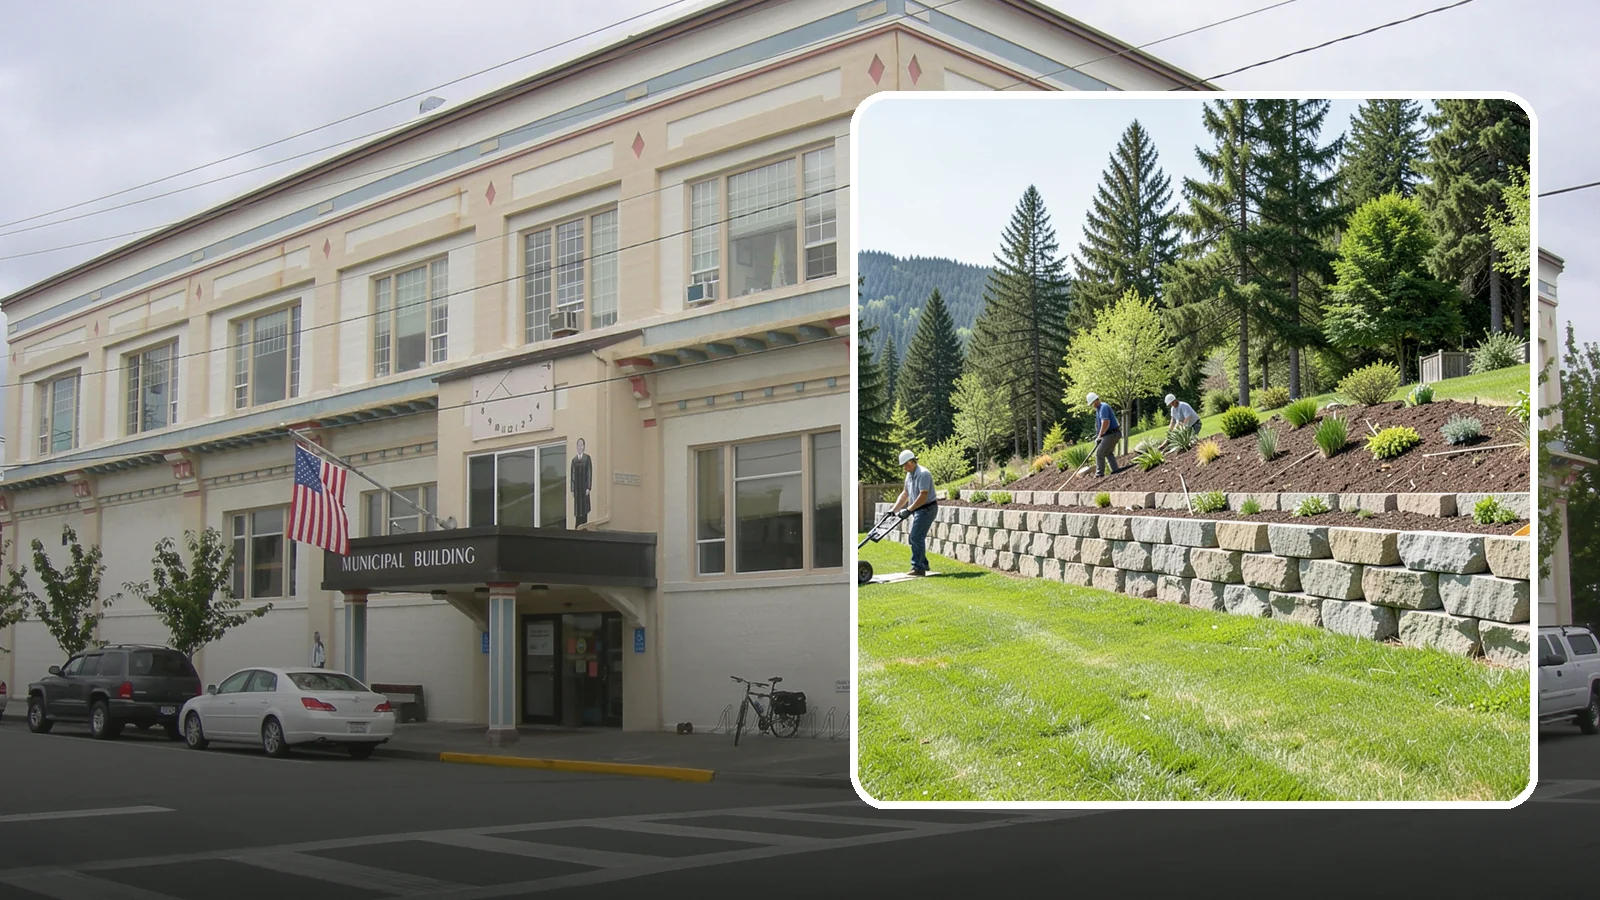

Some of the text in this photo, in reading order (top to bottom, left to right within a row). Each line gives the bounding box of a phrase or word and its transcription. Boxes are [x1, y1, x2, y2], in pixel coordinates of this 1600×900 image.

[547, 362, 551, 370] 6
[342, 546, 475, 572] MUNICIPAL BUILDING
